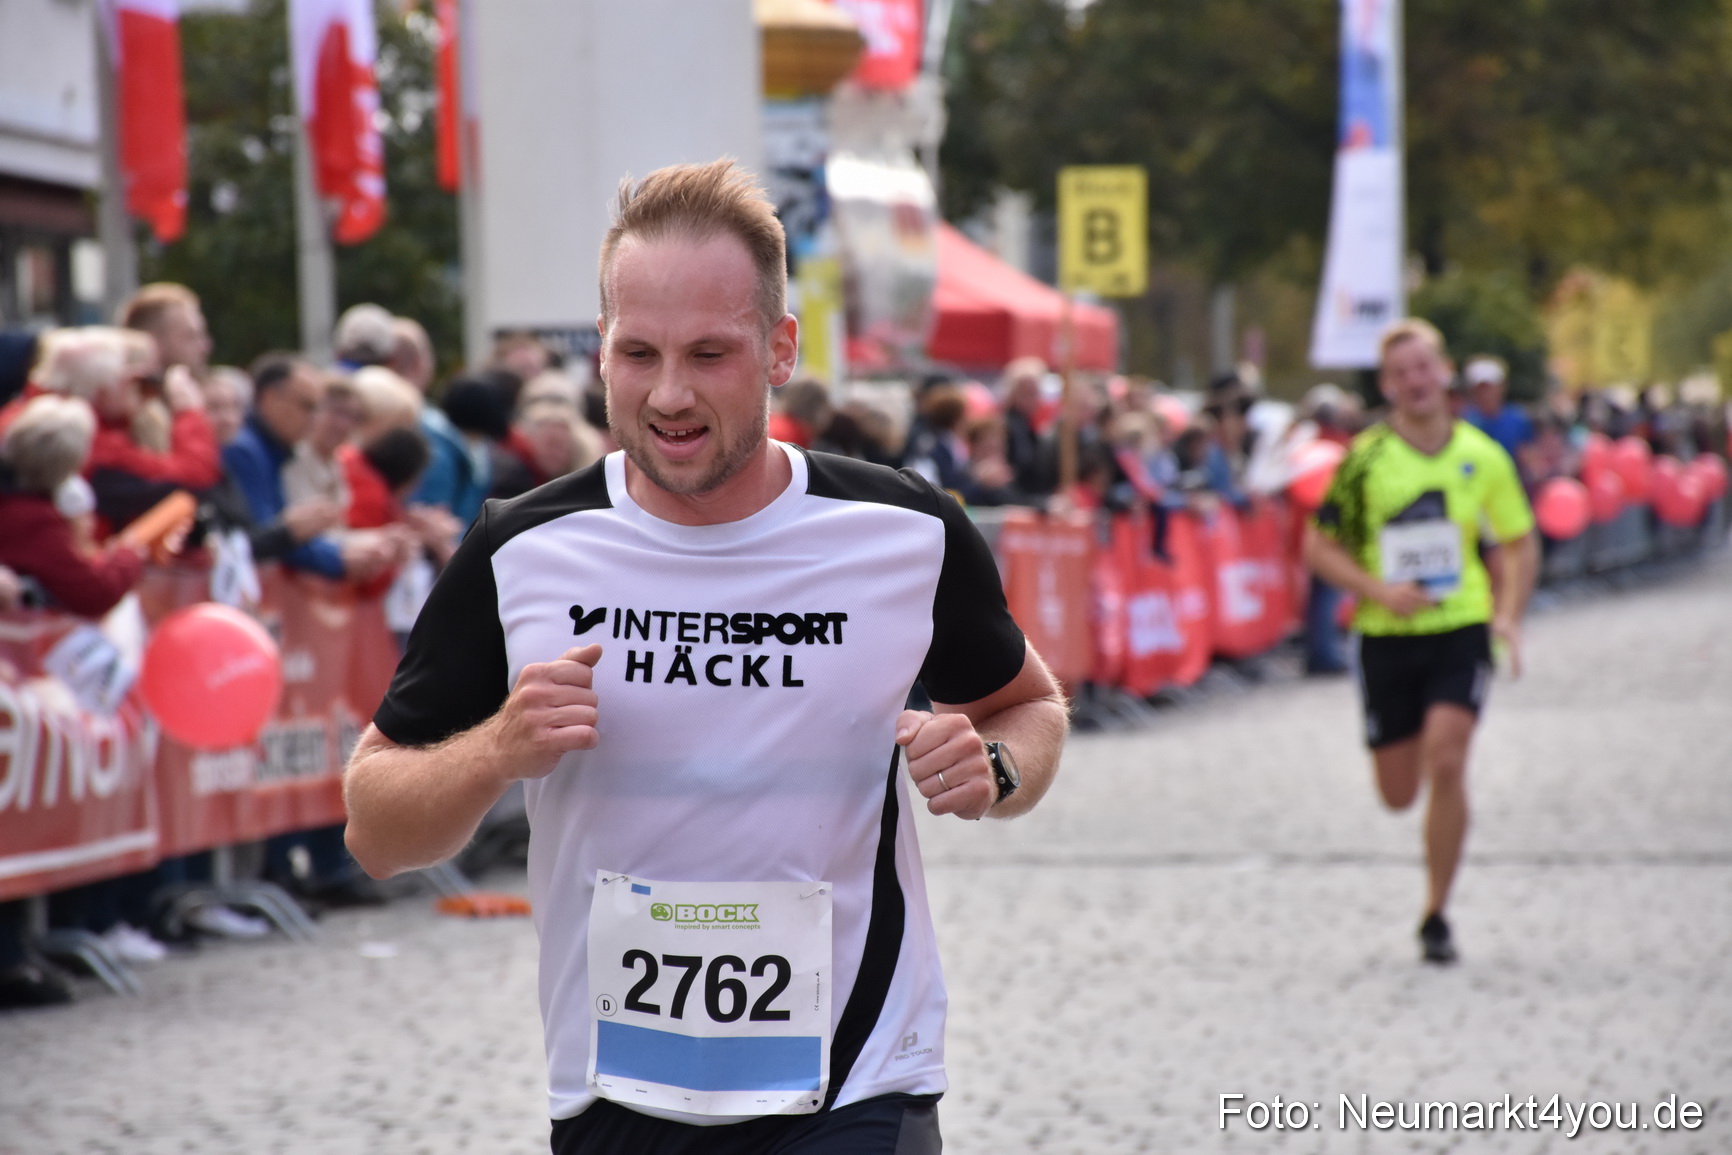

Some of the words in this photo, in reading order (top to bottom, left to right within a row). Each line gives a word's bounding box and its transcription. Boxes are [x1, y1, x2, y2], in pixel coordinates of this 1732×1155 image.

[1083, 208, 1122, 264] B
[612, 607, 848, 645] INTERSPORT
[625, 645, 804, 688] HÄCKL
[675, 903, 760, 922] BOCK
[675, 923, 701, 931] inspired
[702, 923, 710, 931] by
[732, 923, 761, 931] concepts
[622, 949, 792, 1023] 2762
